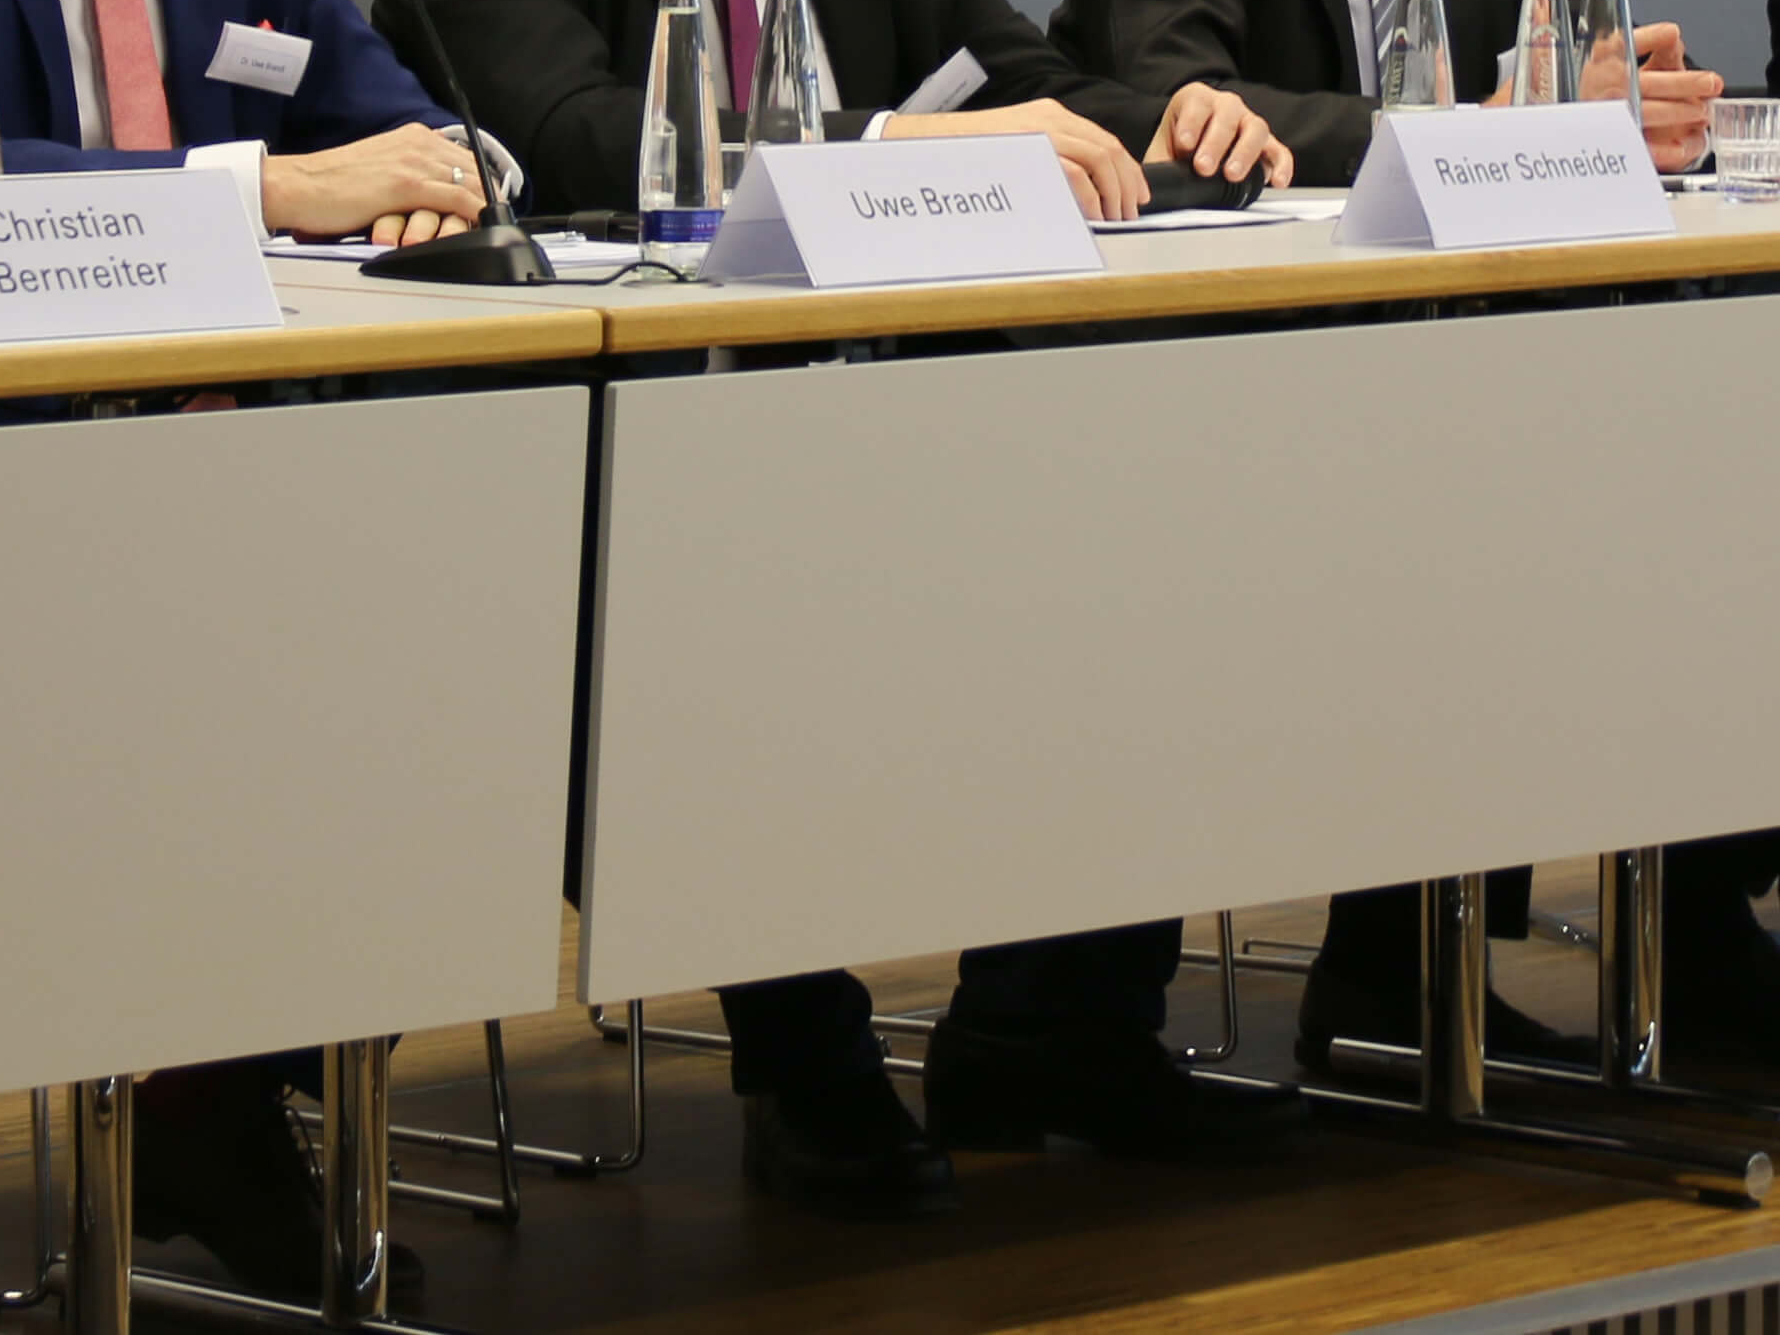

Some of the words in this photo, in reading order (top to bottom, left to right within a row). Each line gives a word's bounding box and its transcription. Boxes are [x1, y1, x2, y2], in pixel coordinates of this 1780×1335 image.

[1434, 156, 1511, 185] Rainer
[1514, 148, 1628, 181] Schneider
[850, 190, 917, 220] Uwe
[920, 184, 1012, 216] Brandl
